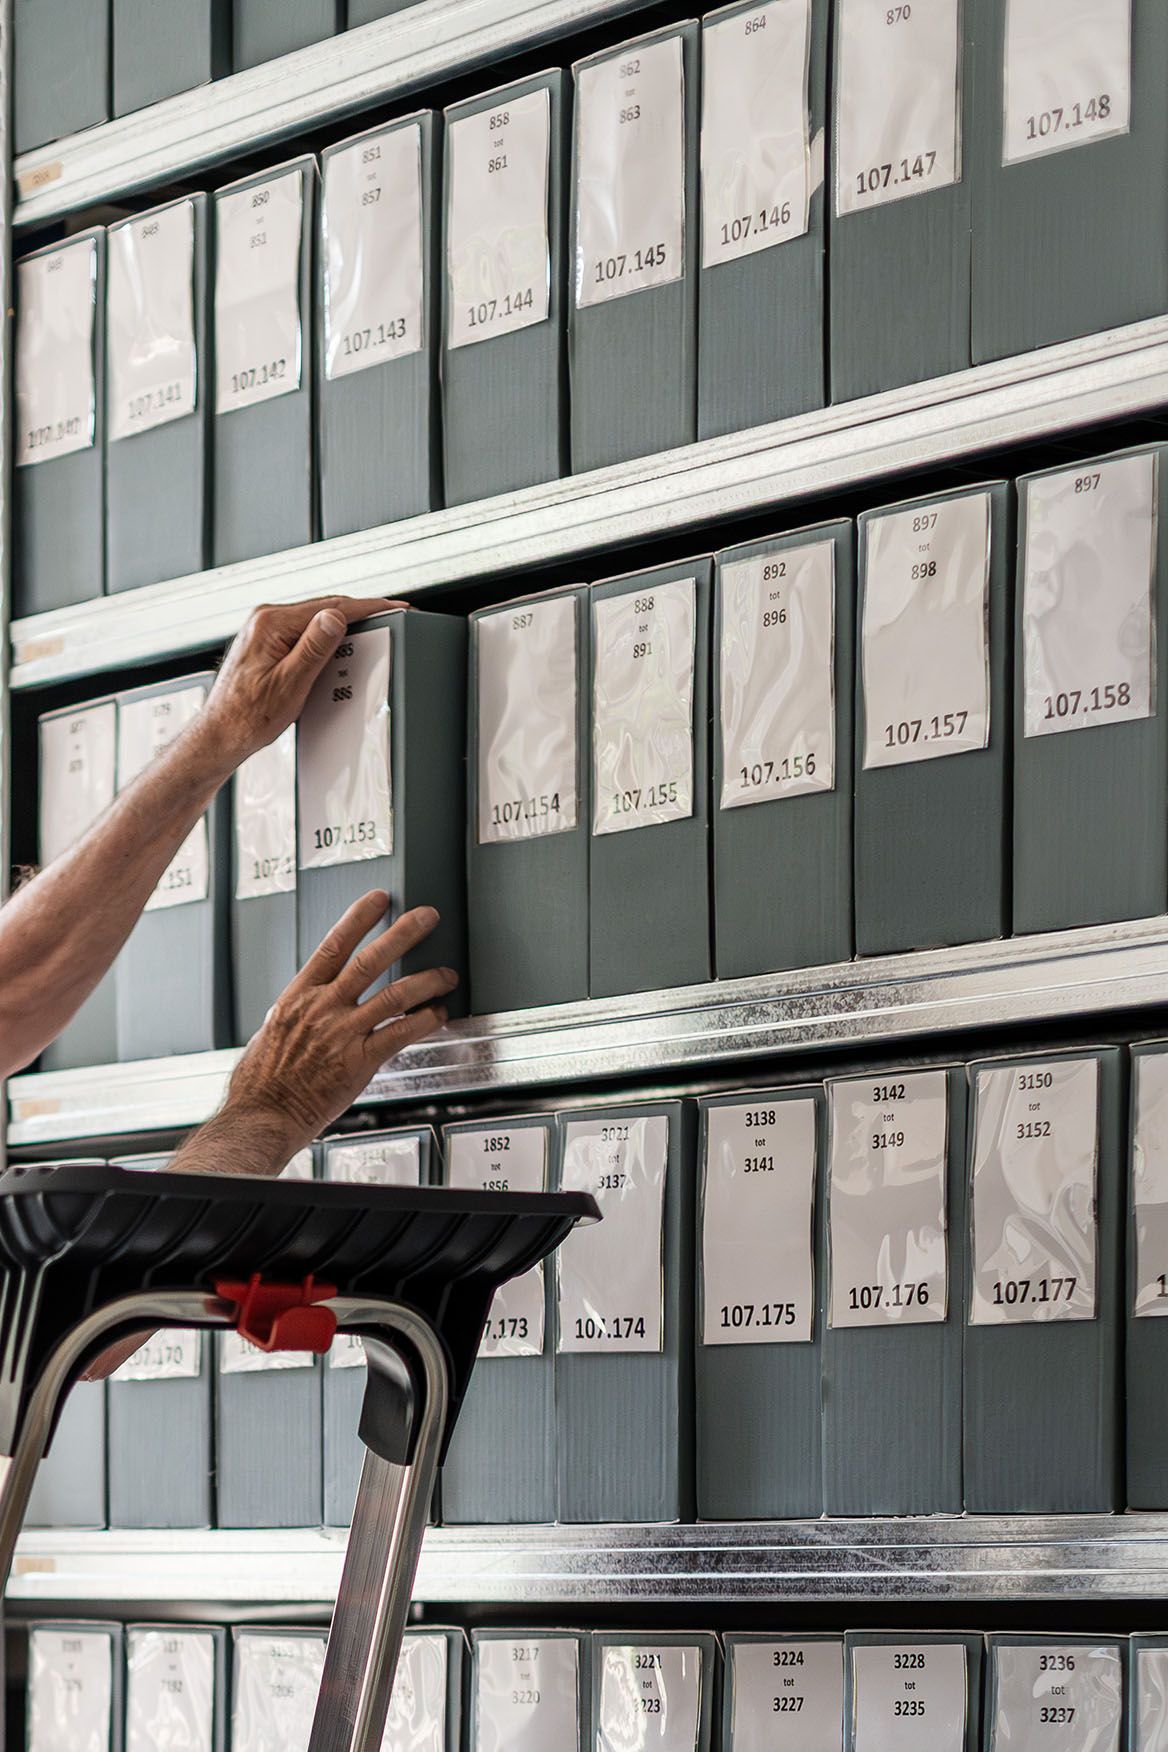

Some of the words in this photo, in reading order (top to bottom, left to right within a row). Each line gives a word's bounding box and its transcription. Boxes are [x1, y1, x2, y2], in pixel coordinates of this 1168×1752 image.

[885, 4, 911, 25] 870
[744, 15, 766, 35] 864
[619, 59, 641, 79] 862
[489, 112, 510, 130] 858
[619, 105, 641, 124] 863
[1026, 94, 1111, 140] 107.148
[362, 146, 381, 164] 851
[488, 155, 508, 173] 861
[856, 151, 937, 195] 107.147
[362, 188, 381, 206] 857
[720, 202, 791, 245] 107.146
[594, 243, 666, 283] 107.145
[467, 287, 534, 328] 107.144
[343, 317, 406, 356] 107.143
[231, 359, 287, 393] 107.142
[1074, 473, 1101, 493] 897
[912, 513, 938, 532] 897
[918, 542, 930, 553] tot
[763, 562, 787, 580] 892
[911, 560, 937, 580] 898
[633, 596, 655, 614] 888
[769, 591, 781, 601] tot
[513, 613, 534, 630] 887
[763, 608, 787, 627] 896
[633, 642, 652, 659] 891
[1043, 682, 1130, 720] 107.158
[884, 711, 969, 748] 107.157
[740, 752, 817, 788] 107.156
[612, 781, 678, 815] 107.155
[492, 793, 560, 826] 107.154
[314, 821, 377, 849] 107.153
[253, 855, 295, 881] 107.1
[163, 867, 192, 890] .151
[1018, 1072, 1053, 1091] 3150
[873, 1084, 906, 1102] 3142
[1029, 1102, 1041, 1112] tot
[745, 1110, 776, 1127] 3138
[883, 1113, 895, 1122] tot
[601, 1127, 630, 1142] 3021
[1016, 1120, 1051, 1139] 3152
[483, 1137, 510, 1152] 1852
[754, 1137, 766, 1147] tot
[872, 1131, 905, 1149] 3149
[744, 1157, 775, 1173] 3141
[482, 1179, 509, 1191] 1856
[598, 1174, 626, 1189] 3137
[849, 1282, 929, 1309] 107.176
[992, 1277, 1077, 1305] 107.177
[720, 1303, 796, 1327] 107.175
[484, 1318, 529, 1340] 7.173
[575, 1317, 646, 1339] 107.174
[129, 1345, 183, 1367] 07.170
[512, 1648, 539, 1662] 3217
[635, 1654, 662, 1669] 3221
[773, 1651, 804, 1667] 3224
[894, 1653, 926, 1669] 3228
[1039, 1655, 1075, 1672] 3236
[642, 1680, 653, 1689] tot
[783, 1677, 795, 1687] tot
[904, 1681, 916, 1690] tot
[1050, 1685, 1066, 1695] tot
[512, 1690, 541, 1704] 3220
[773, 1697, 804, 1712] 3227
[894, 1701, 926, 1716] 3235
[1040, 1707, 1076, 1723] 3237
